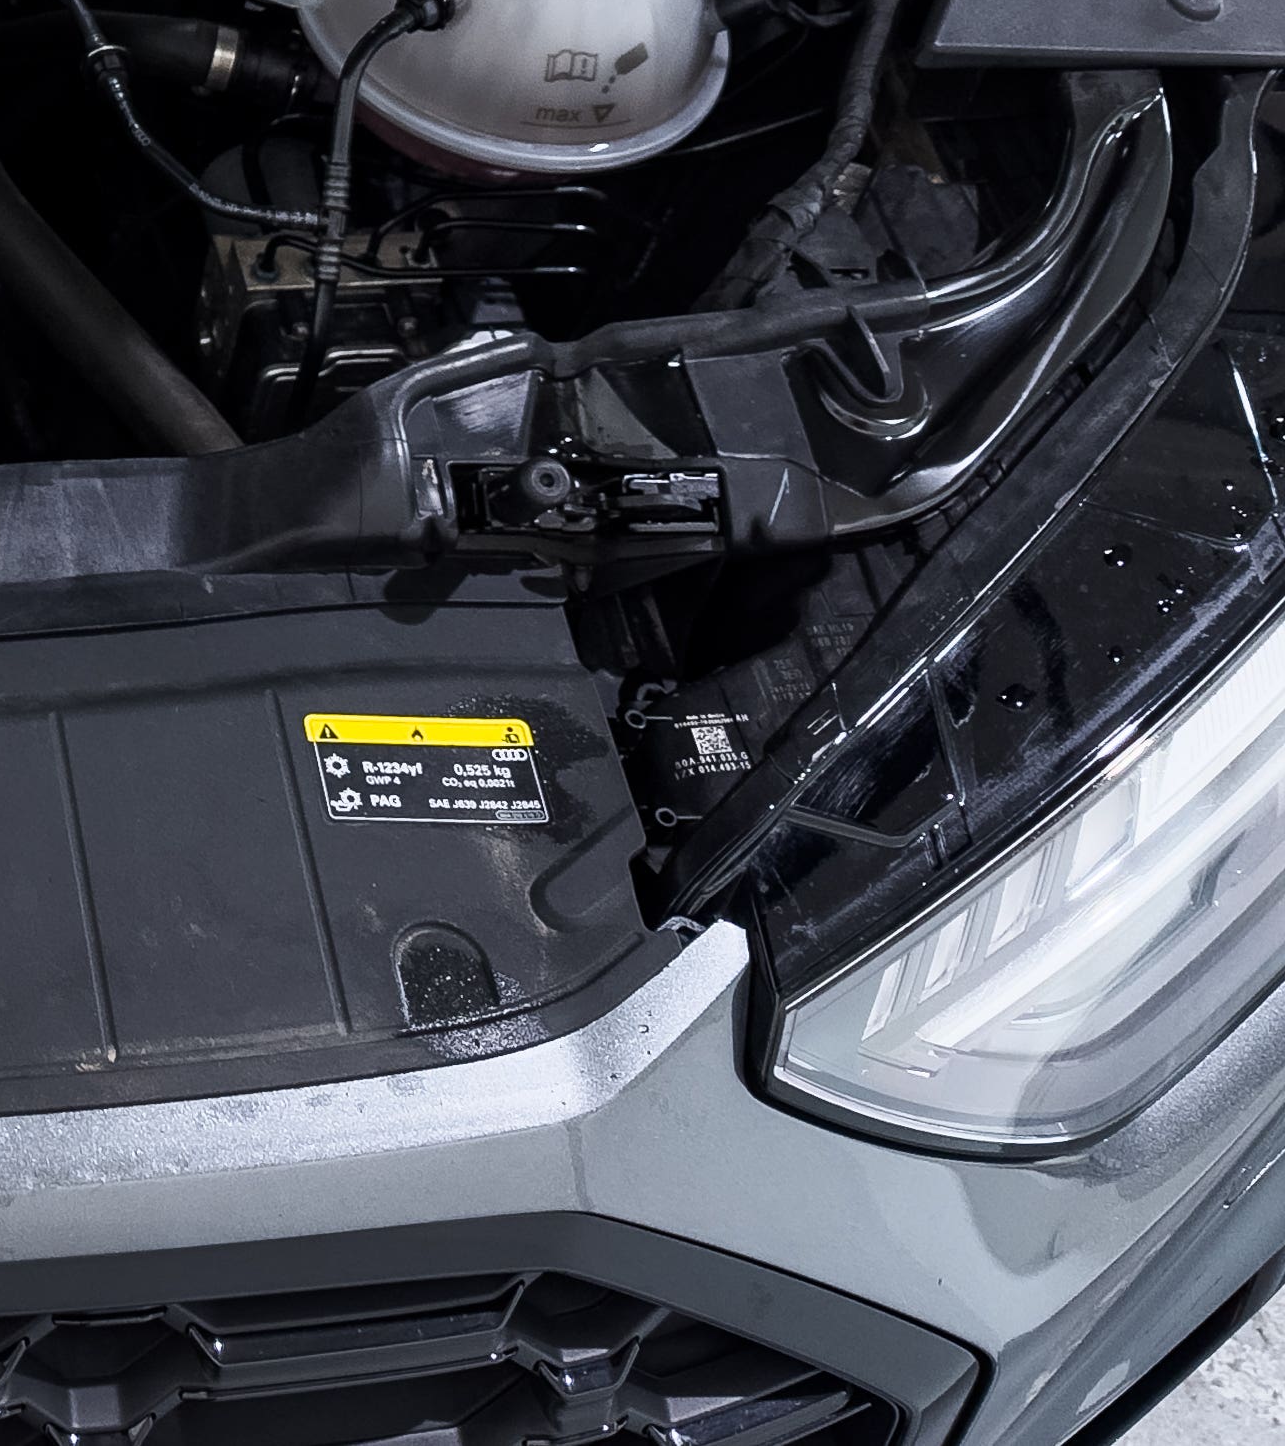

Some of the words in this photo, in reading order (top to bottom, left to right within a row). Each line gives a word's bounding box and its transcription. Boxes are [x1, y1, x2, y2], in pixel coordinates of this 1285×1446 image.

[535, 107, 581, 122] max
[362, 761, 423, 777] R-1234yf
[453, 763, 492, 776] 0,525
[493, 765, 512, 778] kg
[366, 776, 392, 785] GWP
[393, 776, 401, 785] 4
[463, 779, 478, 789] eq
[370, 794, 402, 807] PAG
[429, 798, 451, 809] SAE
[453, 799, 477, 809] J639
[479, 800, 508, 810] J2842
[511, 800, 541, 810] J2845
